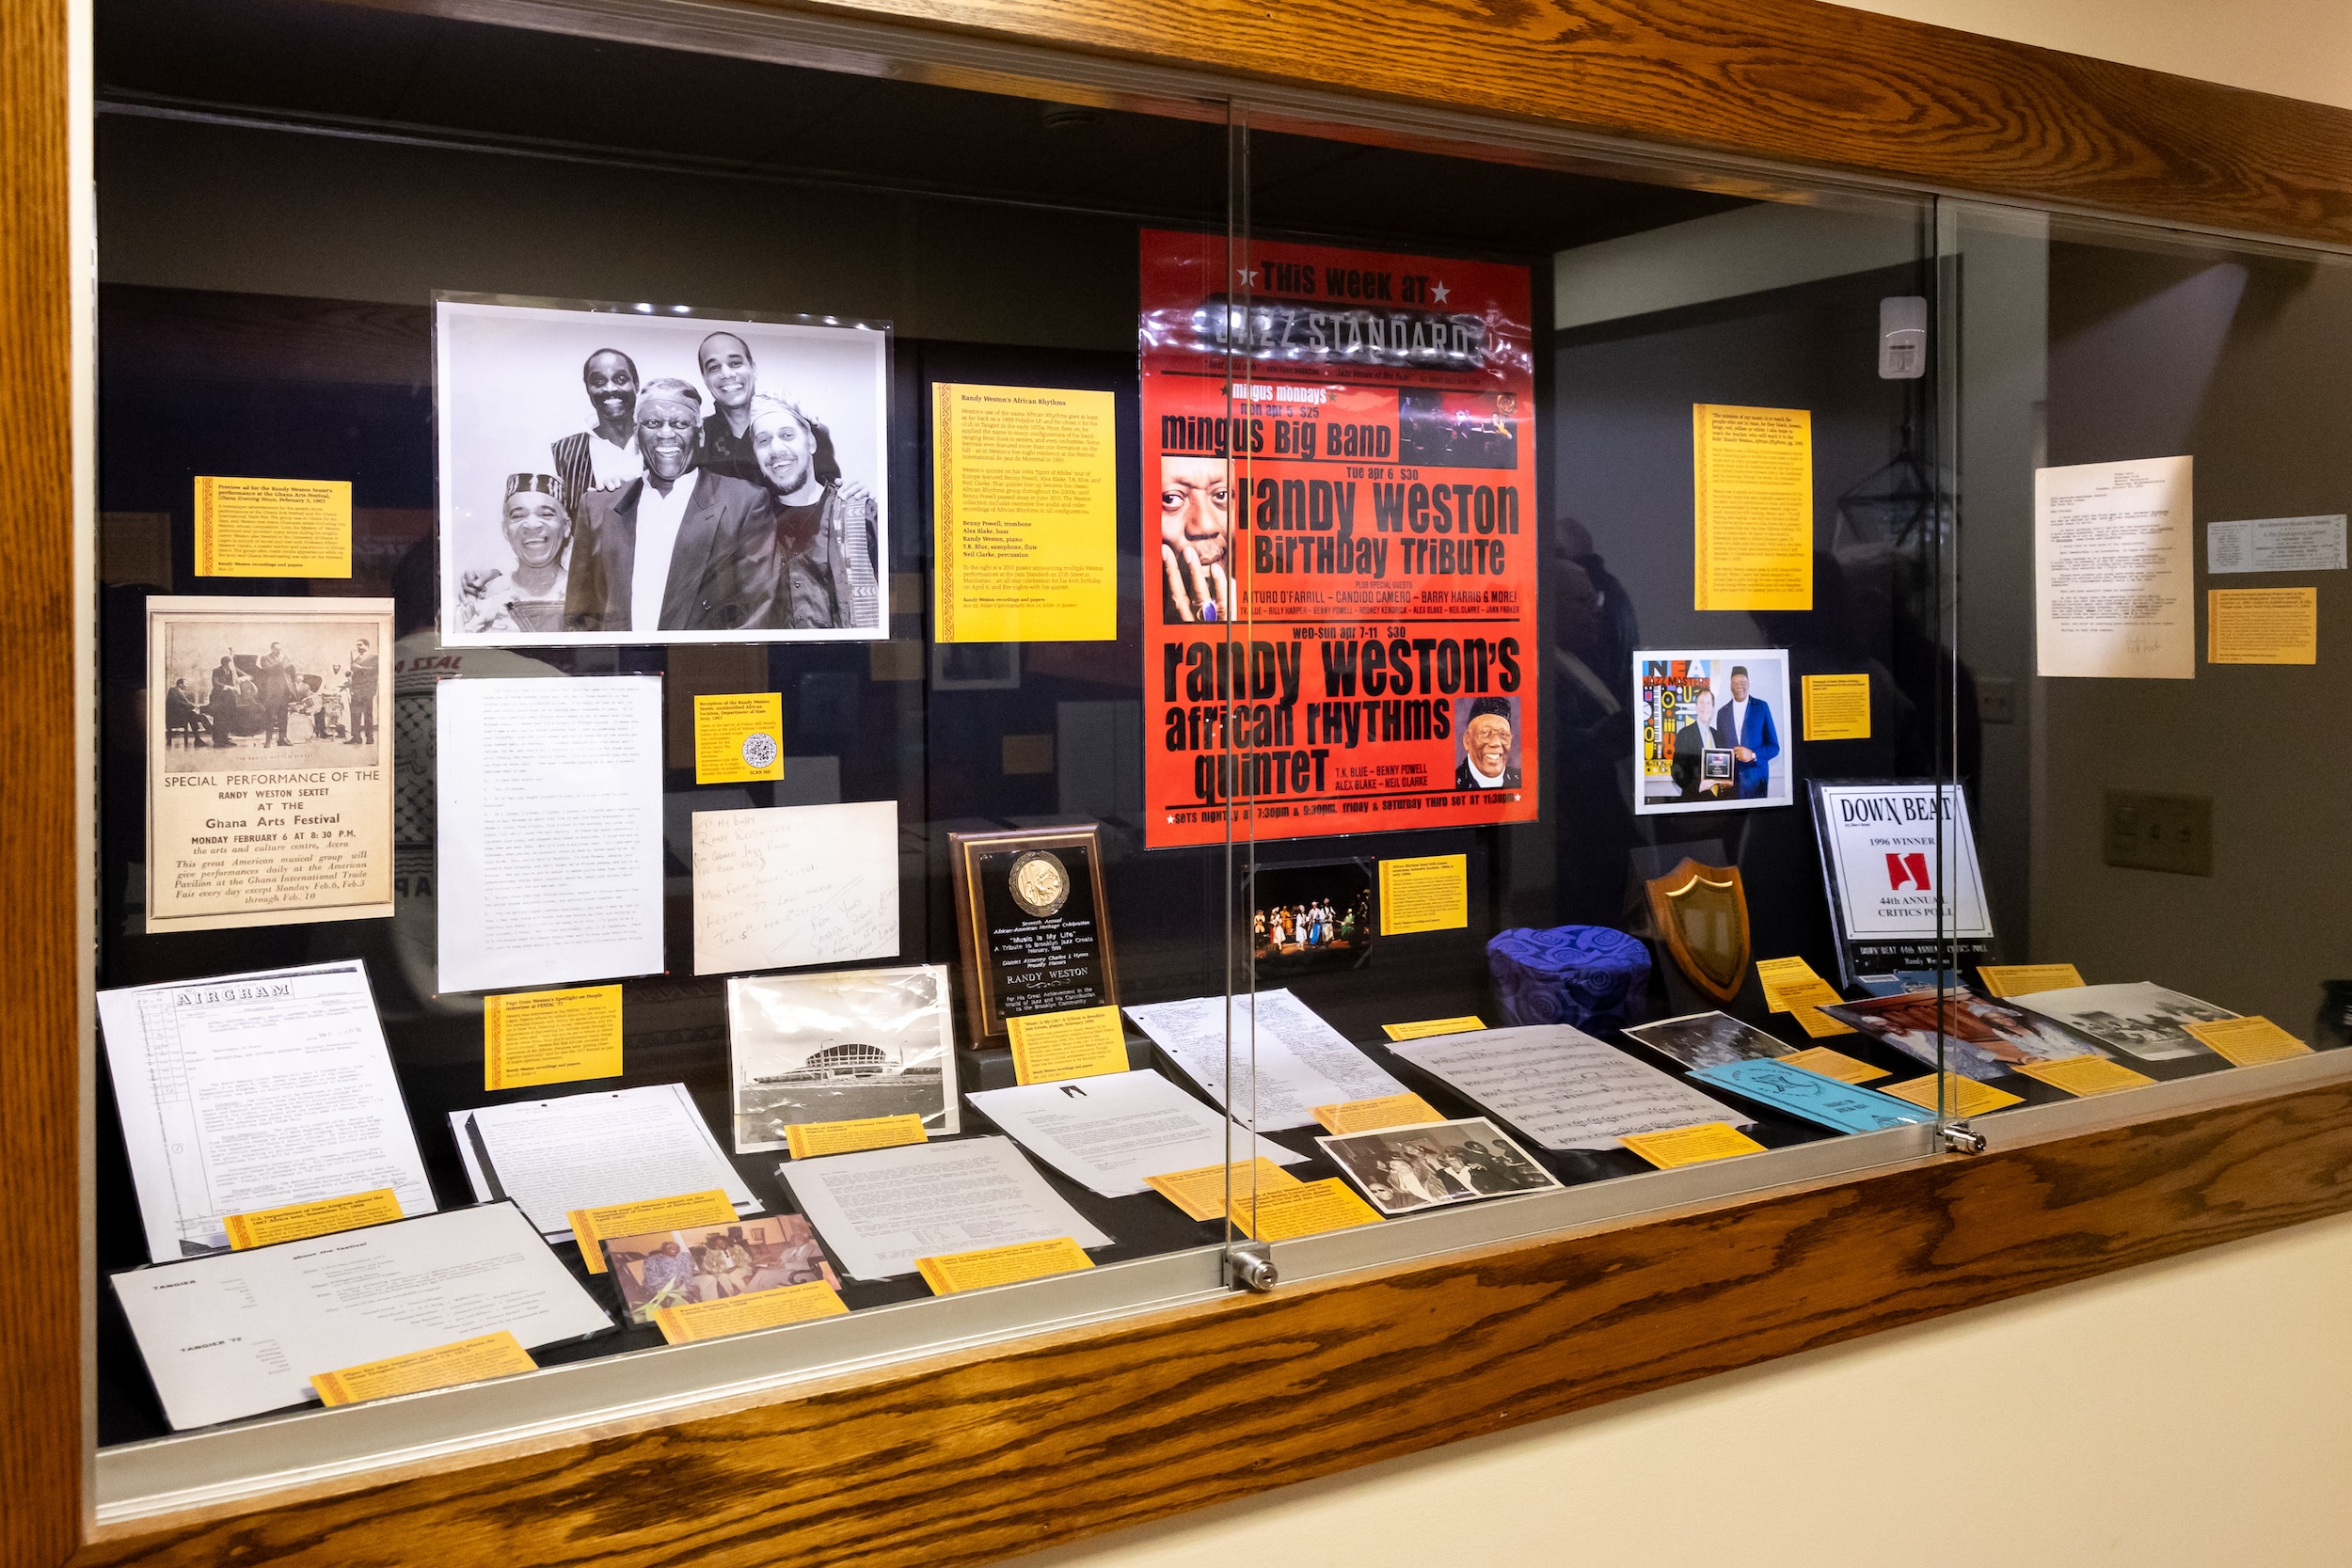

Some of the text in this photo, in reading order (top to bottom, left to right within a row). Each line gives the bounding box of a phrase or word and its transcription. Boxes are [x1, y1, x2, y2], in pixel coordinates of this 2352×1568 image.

[1309, 313, 1468, 359] STANDARD
[1287, 405, 1293, 417] 5
[1300, 406, 1319, 419] $25
[1161, 414, 1263, 457] mingus
[1388, 468, 1394, 480] 6
[1400, 468, 1419, 481] $30
[1243, 591, 1278, 604] ATURO
[1280, 591, 1325, 604] O'FARRILL
[1336, 591, 1373, 604] CANDIDO
[1375, 591, 1411, 604] CAMERO
[1422, 591, 1449, 604] BARRY
[1451, 591, 1481, 604] HARRIS
[1483, 591, 1488, 603] &
[1360, 626, 1377, 638] 7-11
[1387, 626, 1406, 638] $30
[1648, 660, 1707, 677] NEA
[165, 770, 380, 787] SPECIAL PERFORMANCE OF THE
[1350, 768, 1368, 779] BLUE
[1377, 766, 1400, 777] BENNY
[1401, 764, 1428, 776] POWELL
[1335, 777, 1428, 790] ALEX BLAKE NEIL CLARKE
[218, 791, 248, 800] RANDY
[298, 788, 329, 797] SEXTET
[281, 801, 304, 810] THE
[1258, 807, 1289, 818] 7:30pm
[1293, 807, 1298, 816] &
[1373, 801, 1379, 811] &
[1840, 797, 1952, 826] DOWN BEAT
[205, 813, 340, 829] Ghana Arts Festival
[192, 835, 228, 845] MONDAY
[233, 833, 278, 843] FEBRUARY
[1870, 837, 1936, 847] 1996 WINNER
[231, 845, 249, 853] and
[254, 844, 286, 852] culture
[176, 850, 367, 869] This great American musical group will
[177, 871, 196, 880] give
[201, 869, 260, 880] performances
[265, 865, 288, 875] daily
[327, 861, 367, 869] American
[175, 879, 212, 888] Pavilion
[230, 878, 244, 886] the
[247, 876, 277, 884] Ghana
[280, 873, 338, 882] International
[175, 890, 196, 898] Fair
[225, 888, 242, 897] day
[245, 887, 272, 895] except
[276, 884, 310, 894] Monday
[245, 895, 279, 905] through
[305, 892, 316, 900] 10
[1880, 896, 1900, 905] 44th
[1878, 909, 1922, 917] CRITICS
[1007, 967, 1089, 984] RANDY WESTON
[177, 984, 290, 1006] AIRGRAM
[293, 1252, 317, 1260] about
[337, 1242, 367, 1252] festival
[152, 1279, 196, 1291] TANGIER
[181, 1340, 226, 1353] TANGIER
